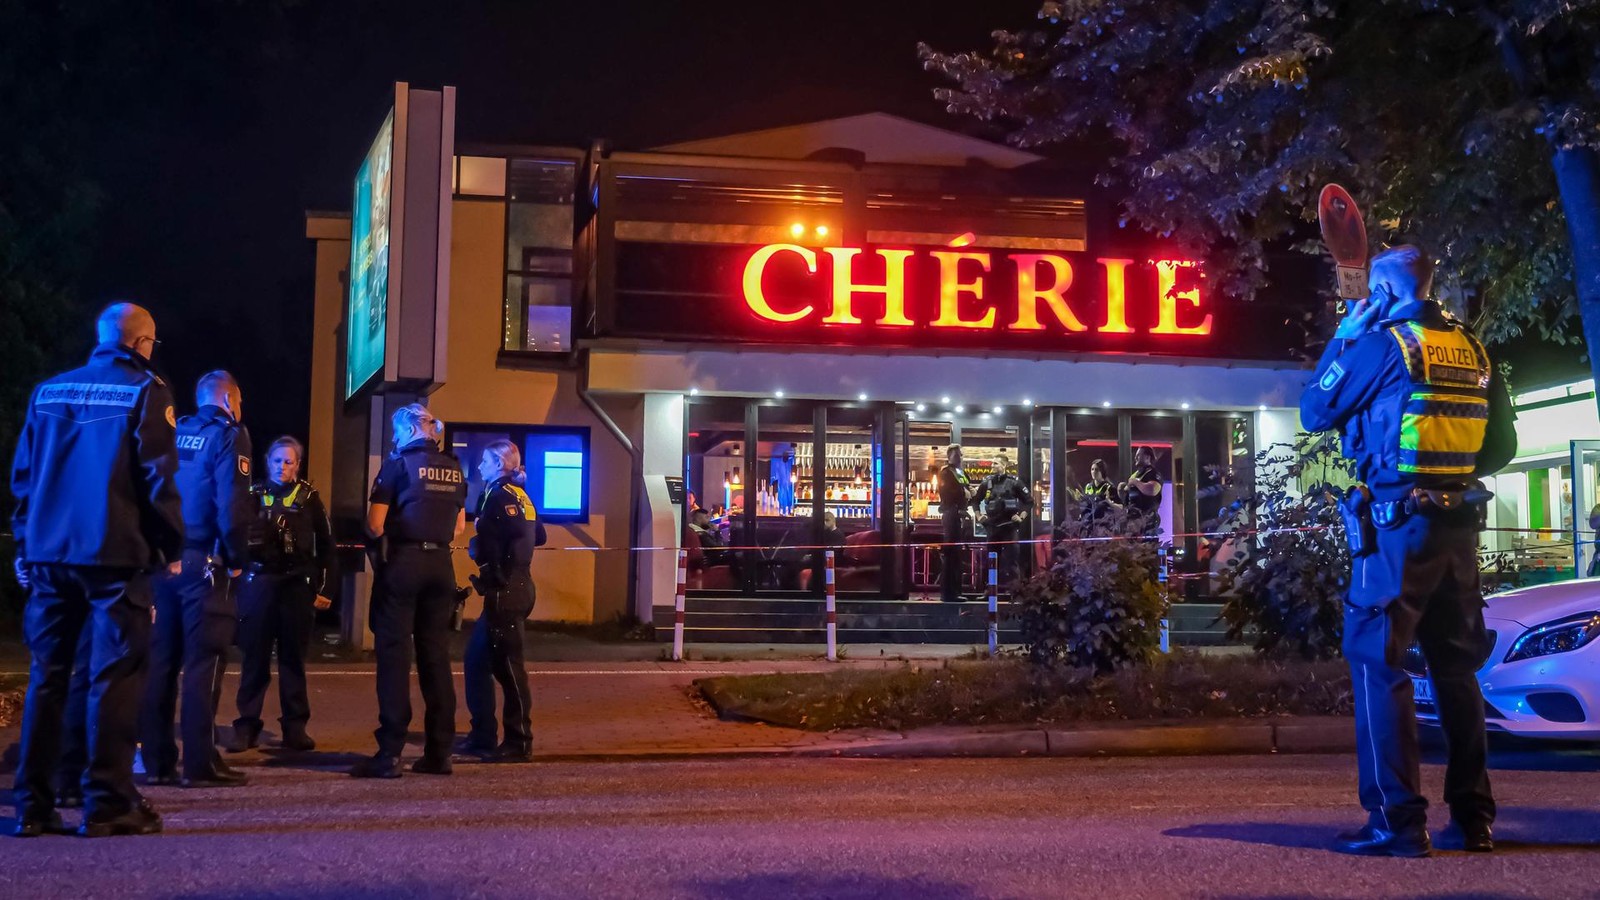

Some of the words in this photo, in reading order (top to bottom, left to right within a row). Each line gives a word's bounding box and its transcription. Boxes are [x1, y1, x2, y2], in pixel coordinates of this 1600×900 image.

[742, 232, 1213, 335] CHÉRIE
[1426, 345, 1475, 366] POLIZEI
[418, 467, 462, 484] POLIZEI
